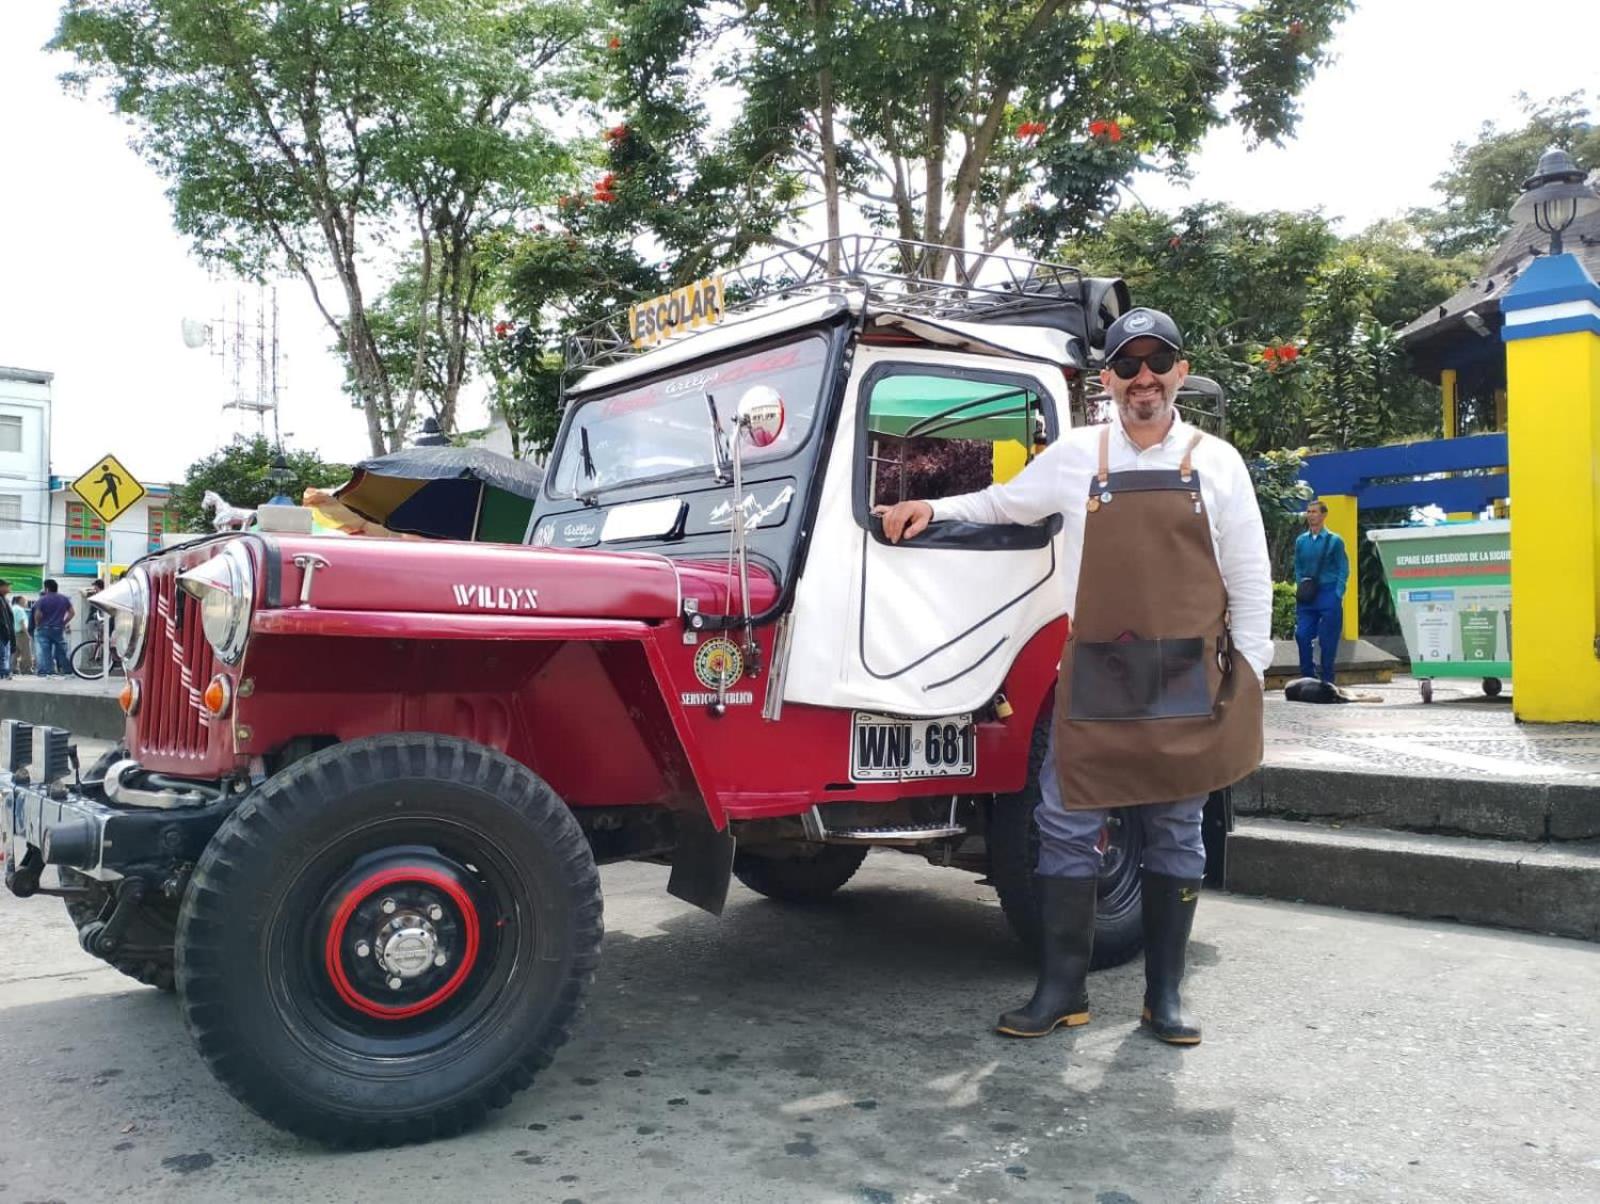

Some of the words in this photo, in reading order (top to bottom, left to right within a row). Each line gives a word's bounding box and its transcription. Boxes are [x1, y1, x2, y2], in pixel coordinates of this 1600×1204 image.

[635, 285, 717, 338] ESCOLAR
[1421, 554, 1435, 565] LOS
[1469, 551, 1480, 562] DE
[1479, 551, 1489, 561] LA
[681, 692, 718, 705] SERVICIO
[719, 691, 753, 705] UBLICO
[858, 724, 913, 769] WNJ
[925, 722, 972, 768] 681
[882, 769, 949, 777] SEVILLA
